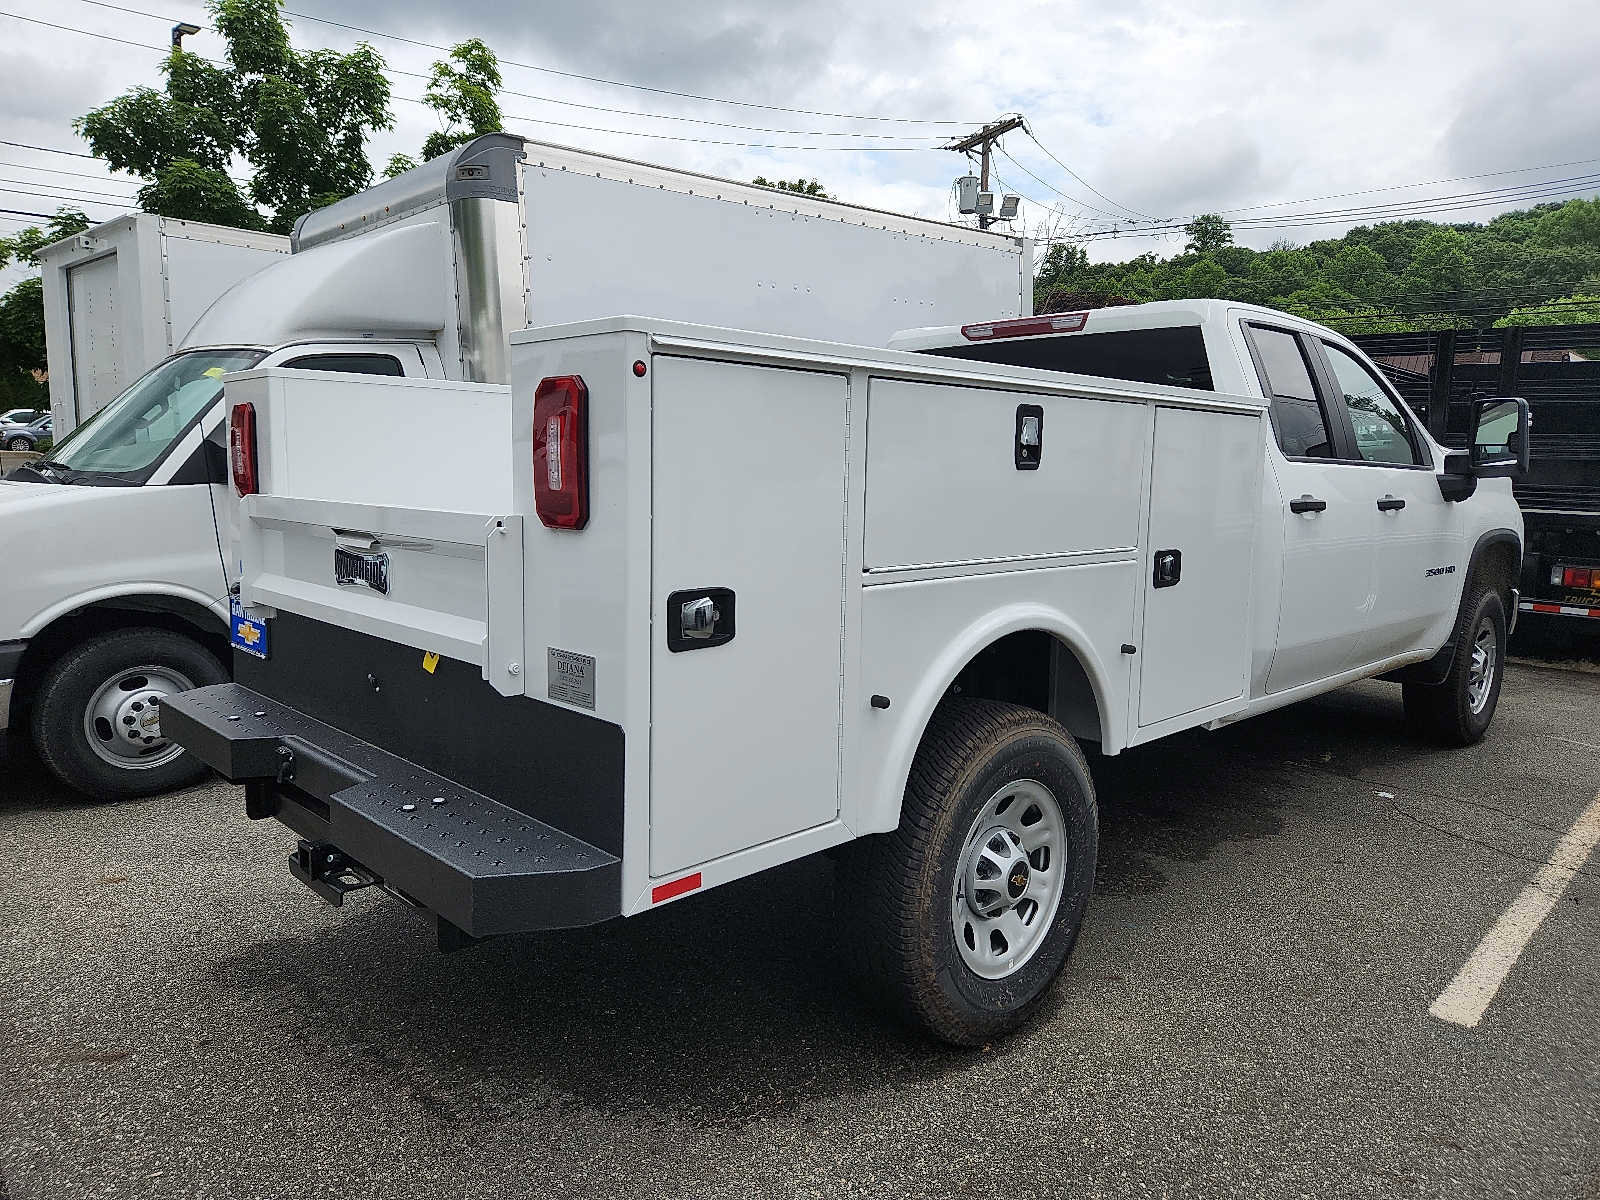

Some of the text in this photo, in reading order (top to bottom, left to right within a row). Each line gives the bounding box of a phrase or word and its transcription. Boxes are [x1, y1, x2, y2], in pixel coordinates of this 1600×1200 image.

[1425, 565, 1456, 577] 3500 HD
[557, 660, 585, 675] DEJANA
